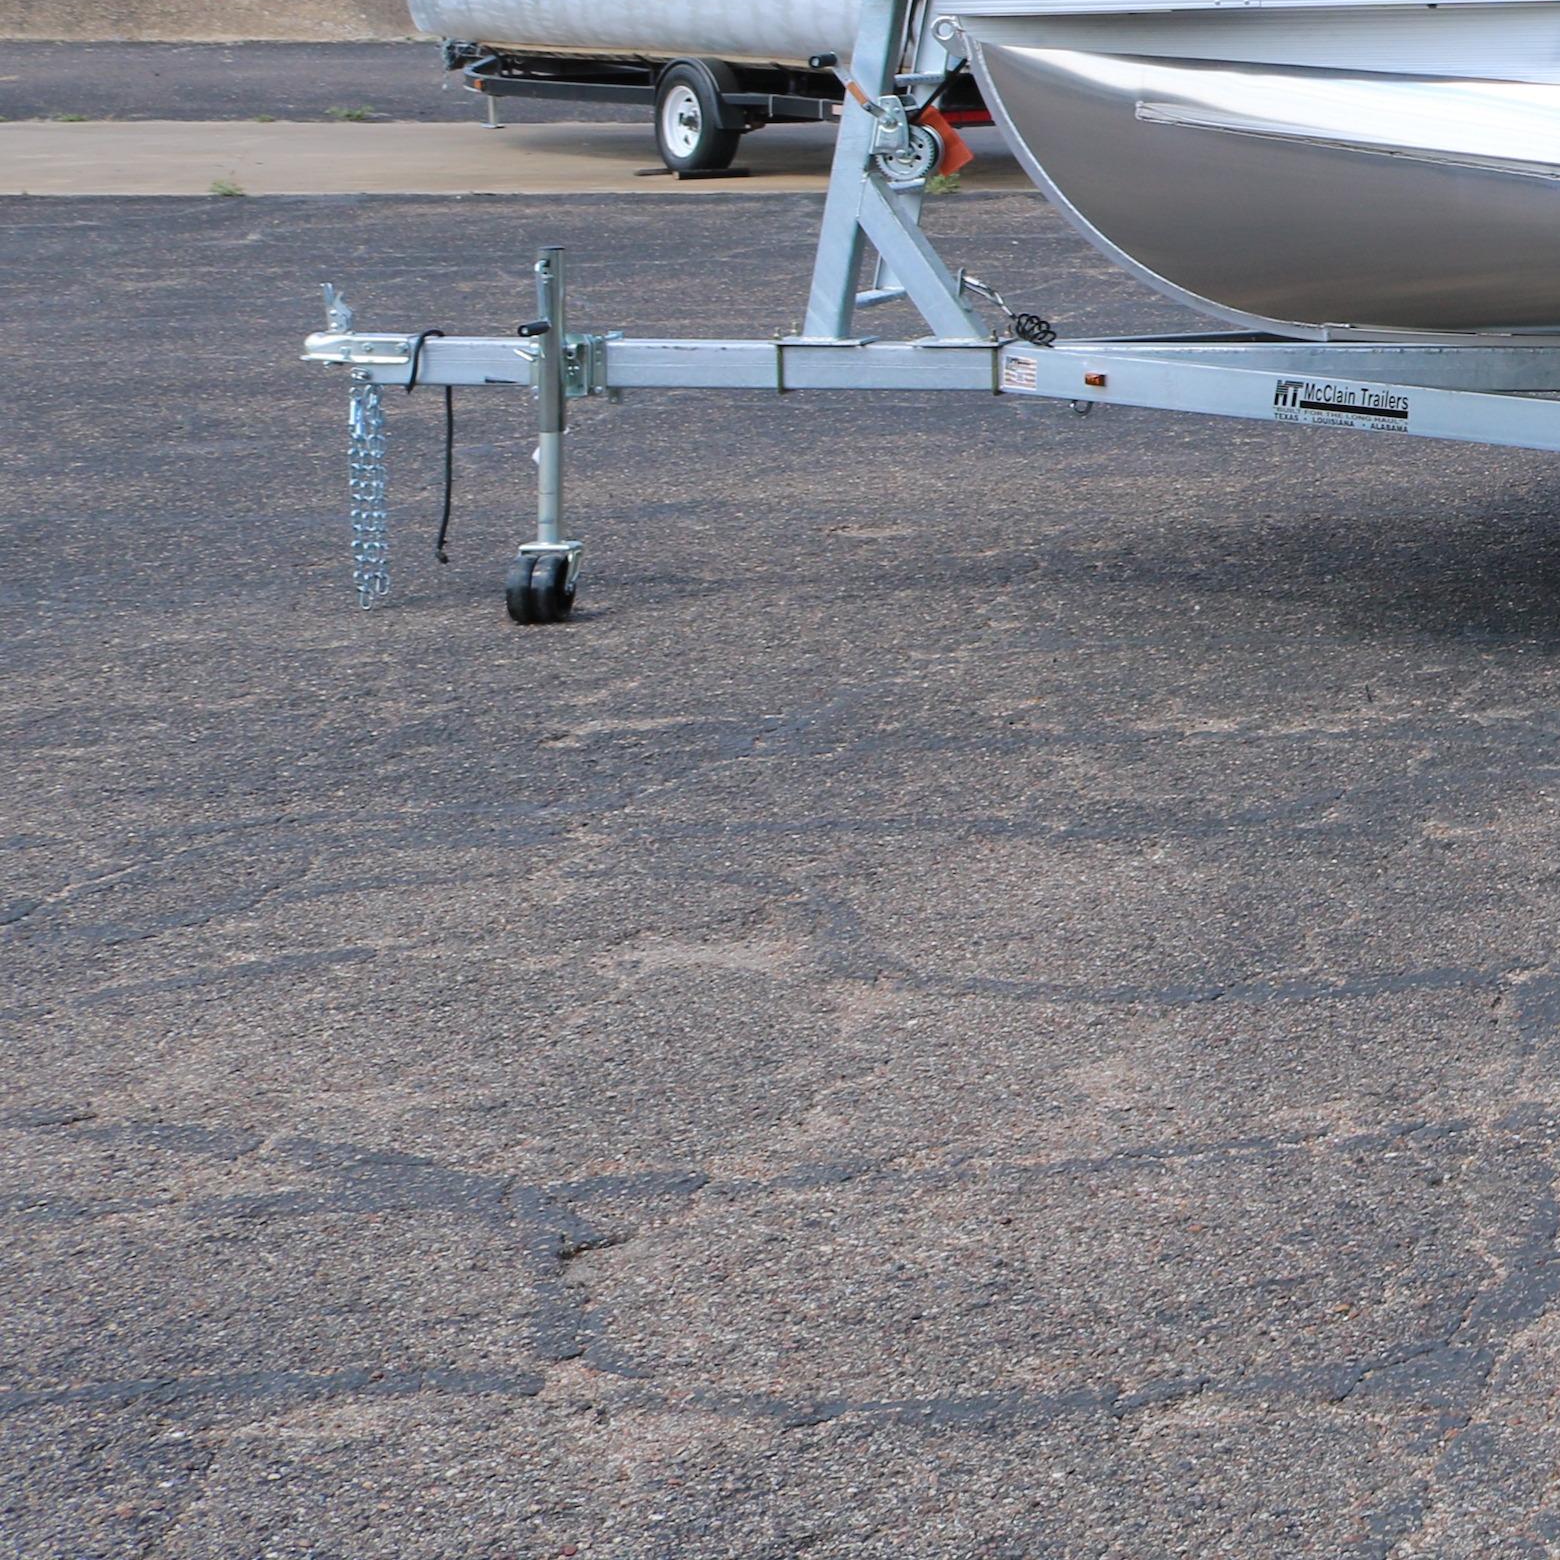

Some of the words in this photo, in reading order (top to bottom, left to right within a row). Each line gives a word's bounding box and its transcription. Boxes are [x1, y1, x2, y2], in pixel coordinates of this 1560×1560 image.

[1303, 382, 1356, 405] McClain
[1361, 388, 1409, 410] Trailers
[1274, 412, 1299, 422] TEXAS
[1311, 417, 1355, 428] LOUISIANA
[1370, 421, 1409, 433] ALABAMA
